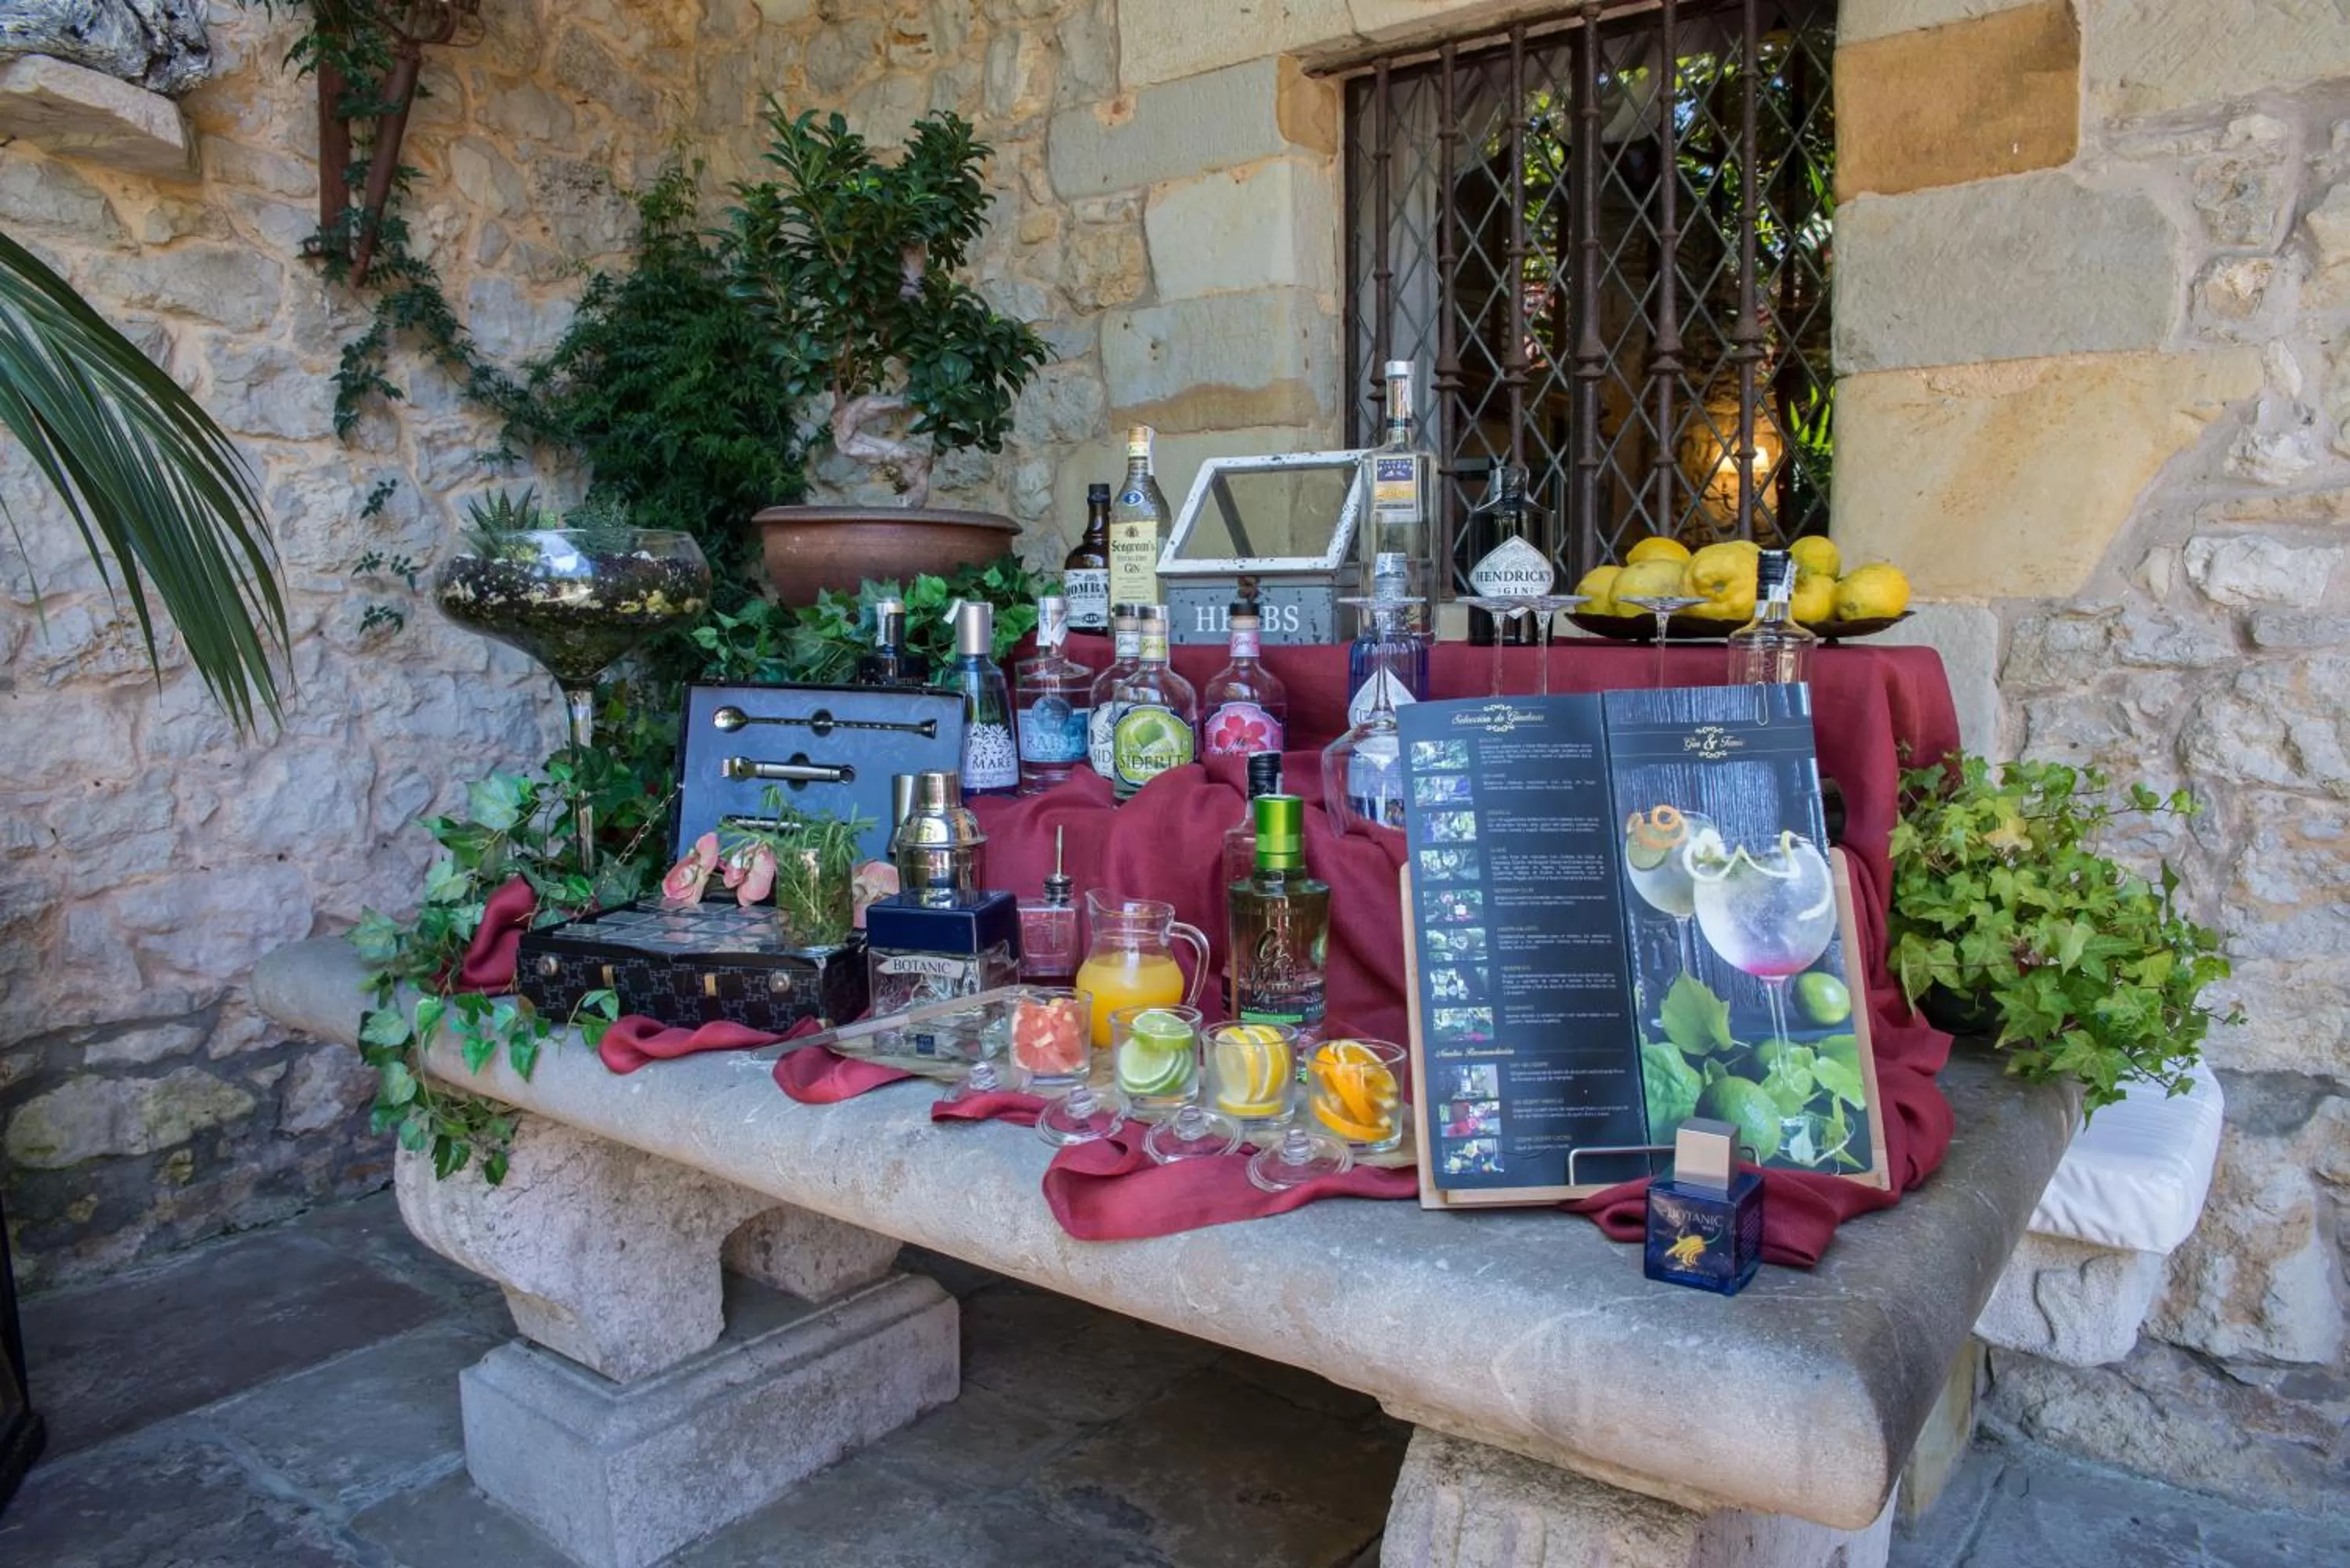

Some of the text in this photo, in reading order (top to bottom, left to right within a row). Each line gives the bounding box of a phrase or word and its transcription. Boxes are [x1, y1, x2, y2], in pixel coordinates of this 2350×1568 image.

[1112, 540, 1155, 555] Seagram's
[1476, 570, 1552, 582] HENDRICK'S
[1195, 605, 1300, 633] HEBS
[1703, 734, 1718, 750] &
[972, 757, 1011, 770] MARE
[1119, 754, 1184, 769] SIDERIT
[893, 958, 951, 975] BOTANIC
